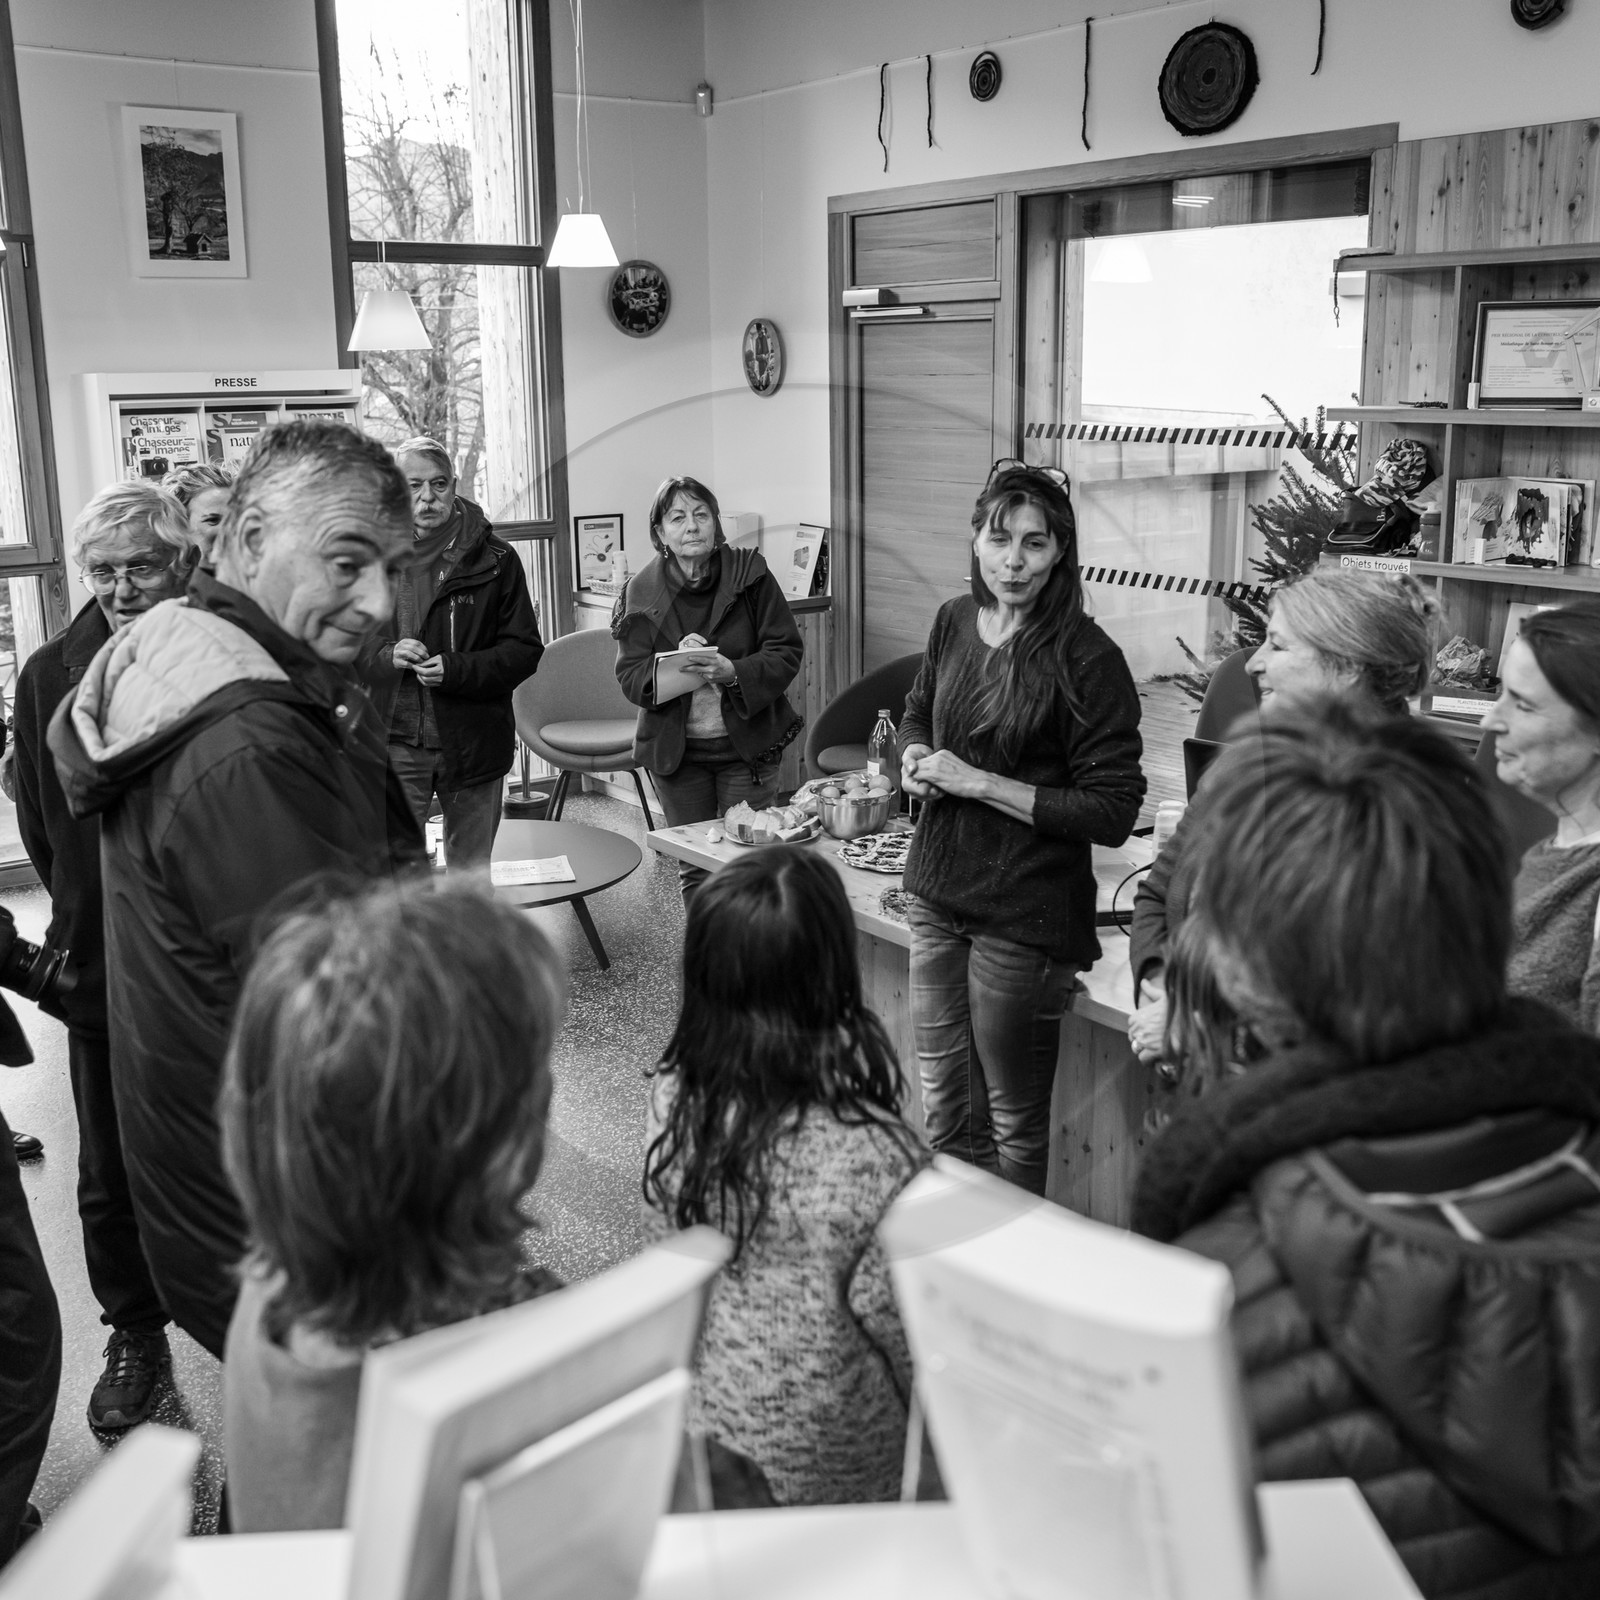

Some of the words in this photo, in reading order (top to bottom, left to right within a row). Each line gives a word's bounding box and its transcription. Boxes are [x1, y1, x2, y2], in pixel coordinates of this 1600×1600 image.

[214, 377, 258, 388] PRESSE
[137, 437, 183, 447] Chasseur
[1342, 556, 1372, 569] Objets
[1374, 560, 1409, 573] trouvés
